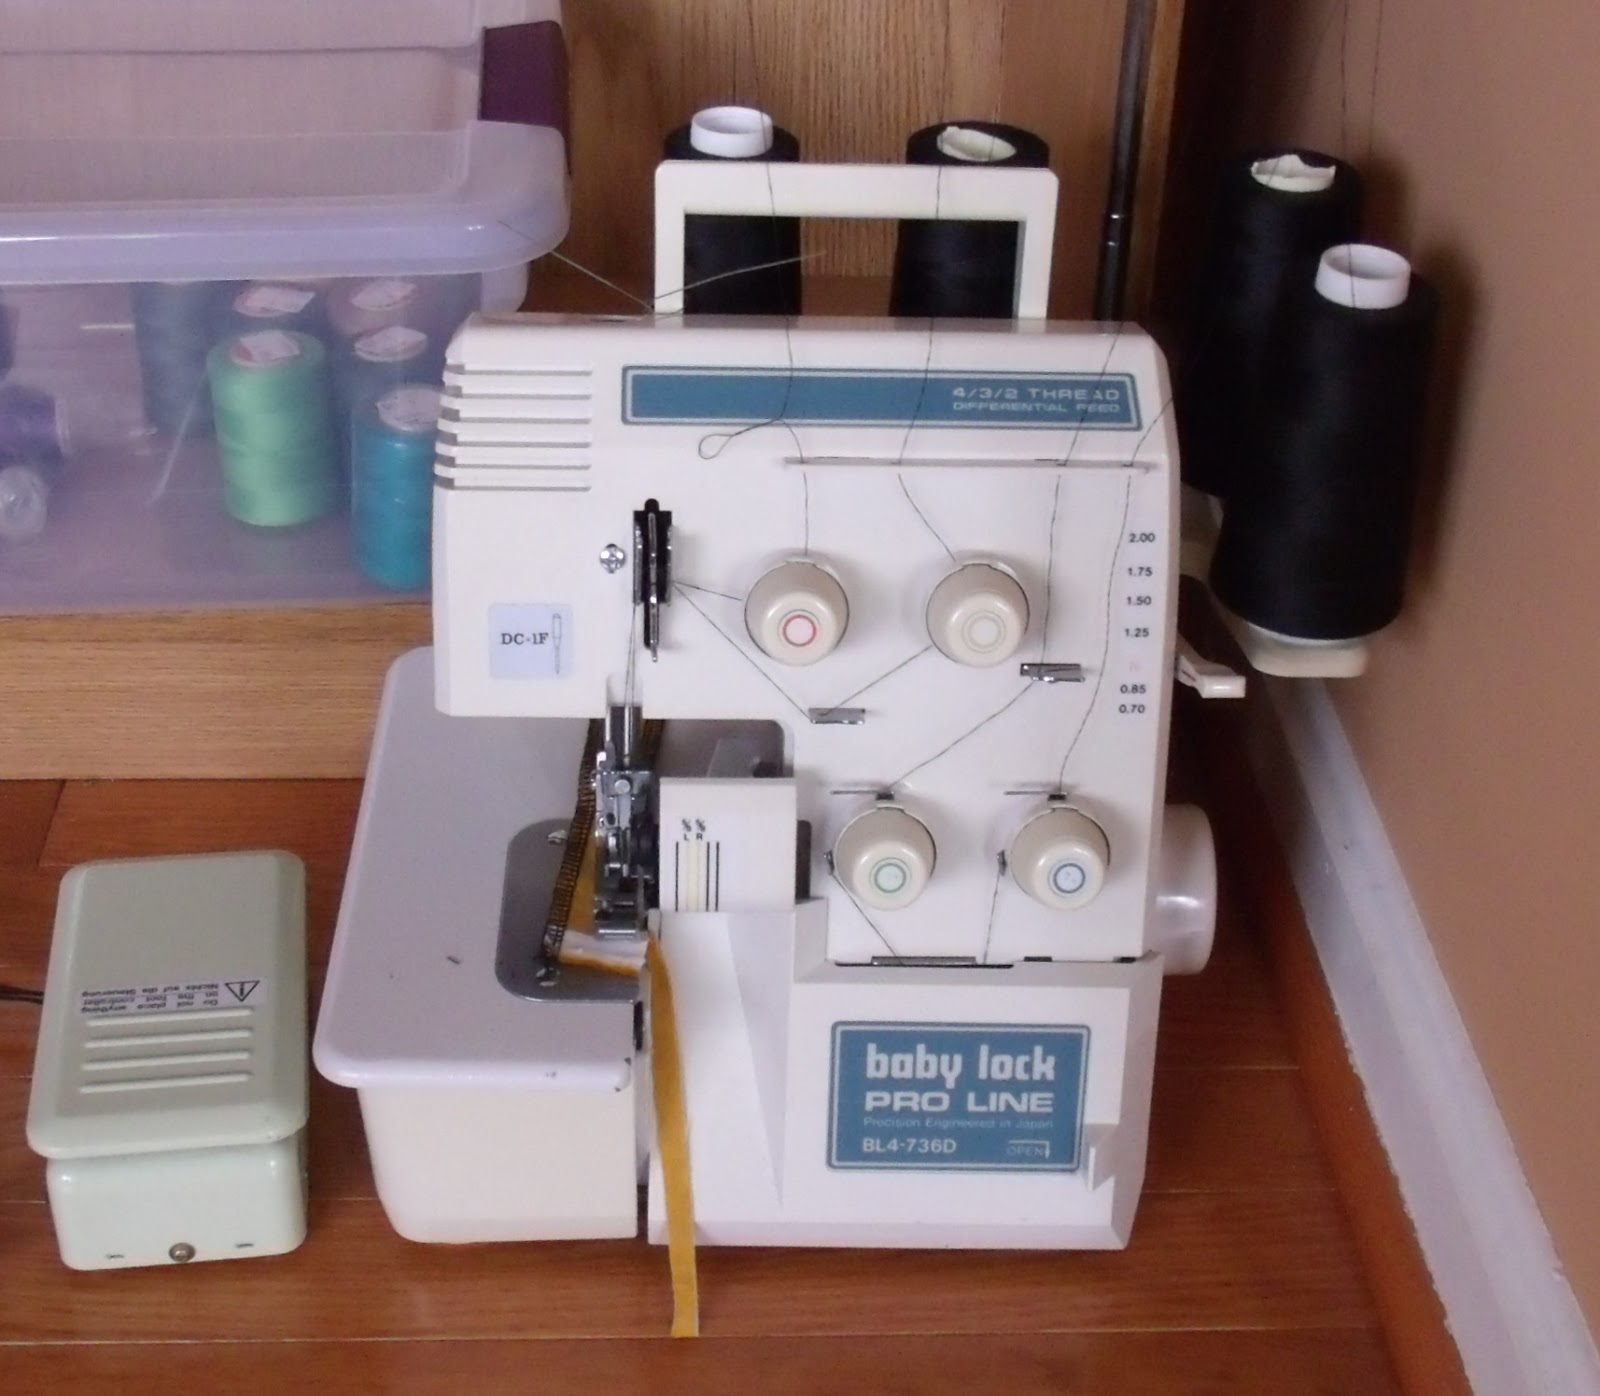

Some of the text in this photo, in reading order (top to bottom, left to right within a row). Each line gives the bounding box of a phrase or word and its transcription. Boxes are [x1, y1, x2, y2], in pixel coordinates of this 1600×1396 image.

[952, 387, 1120, 401] 4/3/2 THREAD
[953, 401, 1121, 413] DIFFERENTIAL FEED
[1129, 532, 1156, 543] 2.00
[1127, 566, 1153, 577] 1.75
[1126, 595, 1152, 606] 1.50
[1124, 627, 1150, 638] 1.25
[500, 632, 549, 645] DC-1F
[1119, 684, 1147, 695] 0.85
[1118, 703, 1146, 714] 0.70
[866, 1042, 1056, 1089] baby lock
[865, 1091, 1055, 1113] PRO LINE
[863, 1117, 1054, 1131] Precision Engineered in Japan
[862, 1138, 957, 1153] BL4-736D
[1006, 1146, 1043, 1156] OPEN
